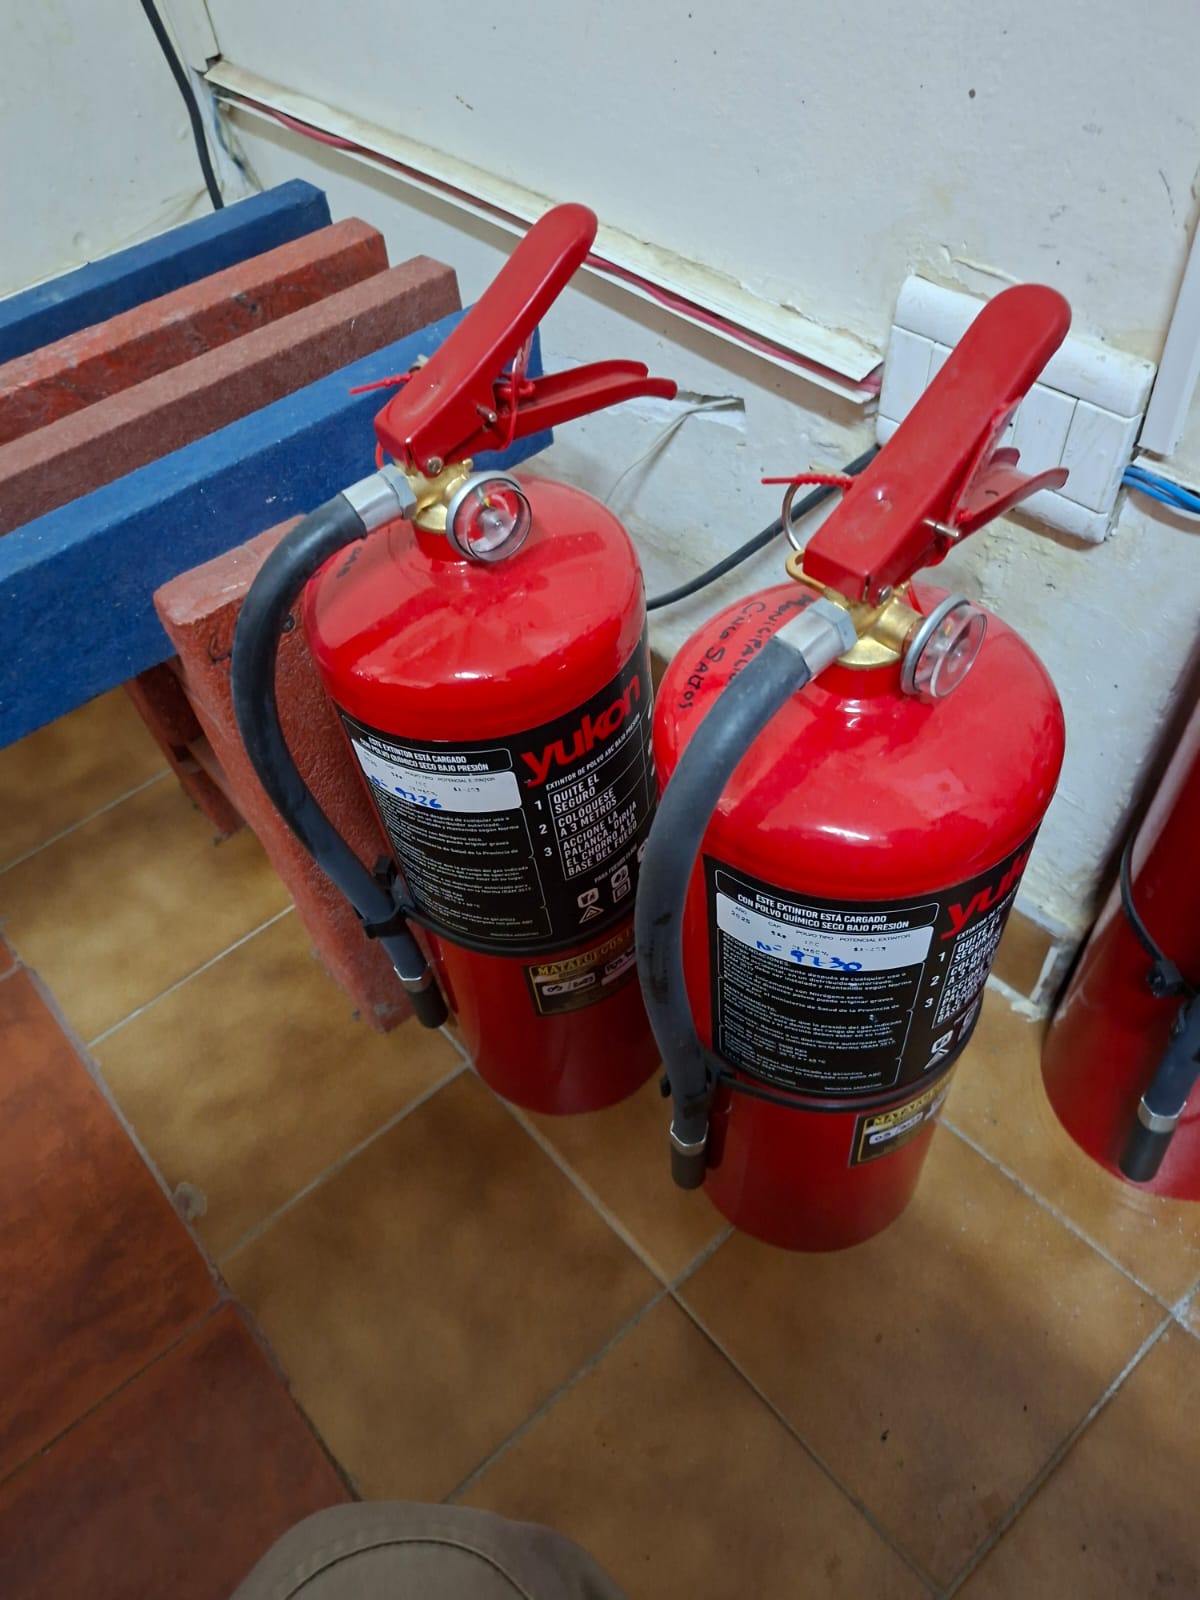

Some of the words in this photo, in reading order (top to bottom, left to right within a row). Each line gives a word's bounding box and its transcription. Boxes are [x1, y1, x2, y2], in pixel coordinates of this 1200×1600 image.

[520, 674, 640, 788] yukon
[383, 745, 413, 758] EXTINTOR
[414, 752, 431, 762] ESTÁ
[432, 755, 467, 764] CARGADO
[419, 762, 437, 770] SECO
[458, 763, 489, 772] PRESIÓN
[546, 772, 576, 791] EXTINTOR
[577, 766, 585, 776] DE
[587, 755, 604, 772] POLVO
[553, 780, 586, 804] QUITE
[587, 773, 600, 786] EL
[554, 787, 596, 814] SEGURO
[534, 800, 543, 811] 1
[558, 787, 614, 828] COLOQUESE
[560, 828, 567, 837] A
[570, 823, 578, 833] 3
[581, 796, 617, 827] METROS
[614, 801, 637, 830] DIRIJA
[539, 824, 548, 834] 2
[563, 820, 605, 850] ACCIONE
[608, 811, 618, 824] LA
[544, 847, 552, 857] 3
[567, 855, 579, 868] EL
[582, 832, 618, 860] CHORRO
[568, 859, 593, 876] BASE
[596, 846, 612, 862] DEL
[614, 820, 637, 849] FUEGO
[737, 894, 754, 907] CON
[755, 902, 781, 918] POLVO
[783, 912, 820, 927] QUÍMICO
[821, 921, 845, 931] SECO
[871, 920, 910, 931] PRESIÓN
[756, 894, 775, 907] ESTE
[777, 902, 818, 919] EXTINTOR
[820, 912, 842, 922] ESTÁ
[844, 915, 887, 923] CARGADO
[878, 933, 911, 942] EXTINTOR
[938, 952, 946, 962] 1
[930, 975, 940, 986] 2
[924, 997, 934, 1008] 3
